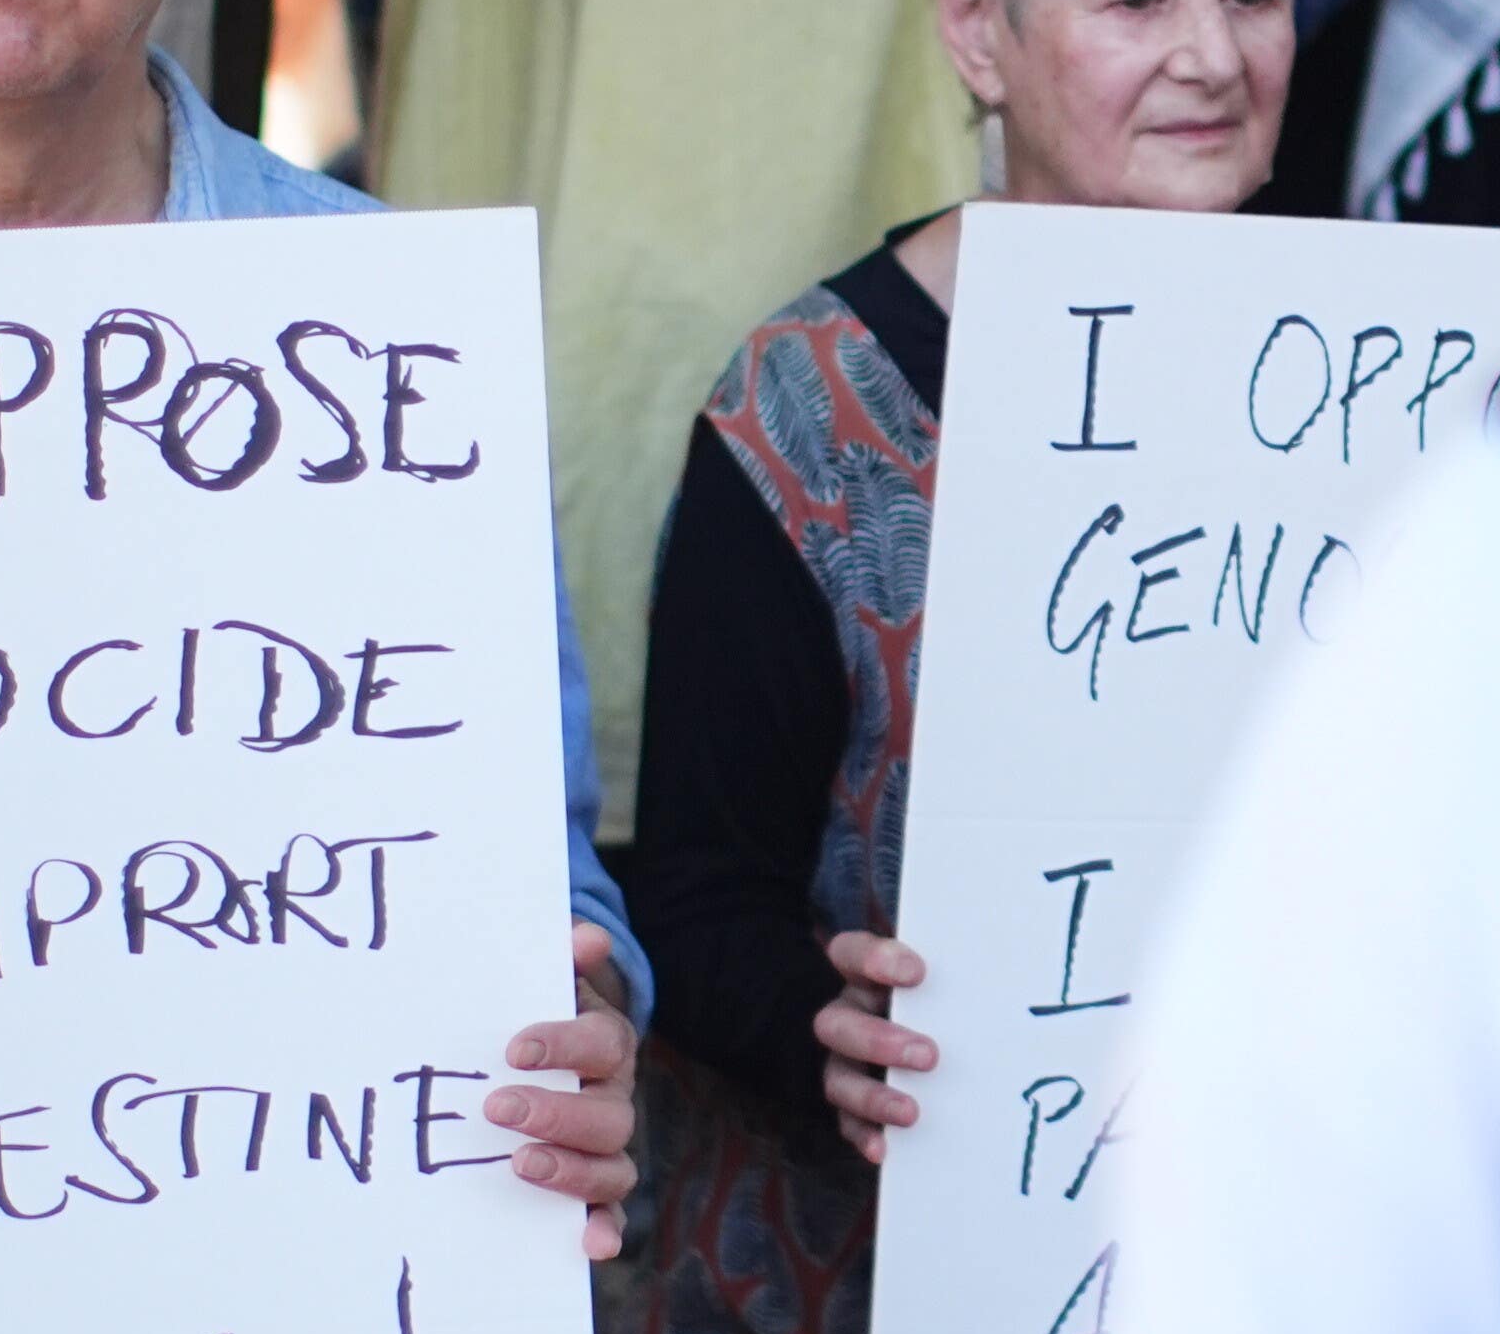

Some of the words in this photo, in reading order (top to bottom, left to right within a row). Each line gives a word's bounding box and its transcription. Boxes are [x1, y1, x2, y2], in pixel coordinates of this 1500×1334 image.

[1050, 305, 1137, 451] I
[1046, 504, 1361, 701] GENO
[1029, 859, 1129, 1016] I
